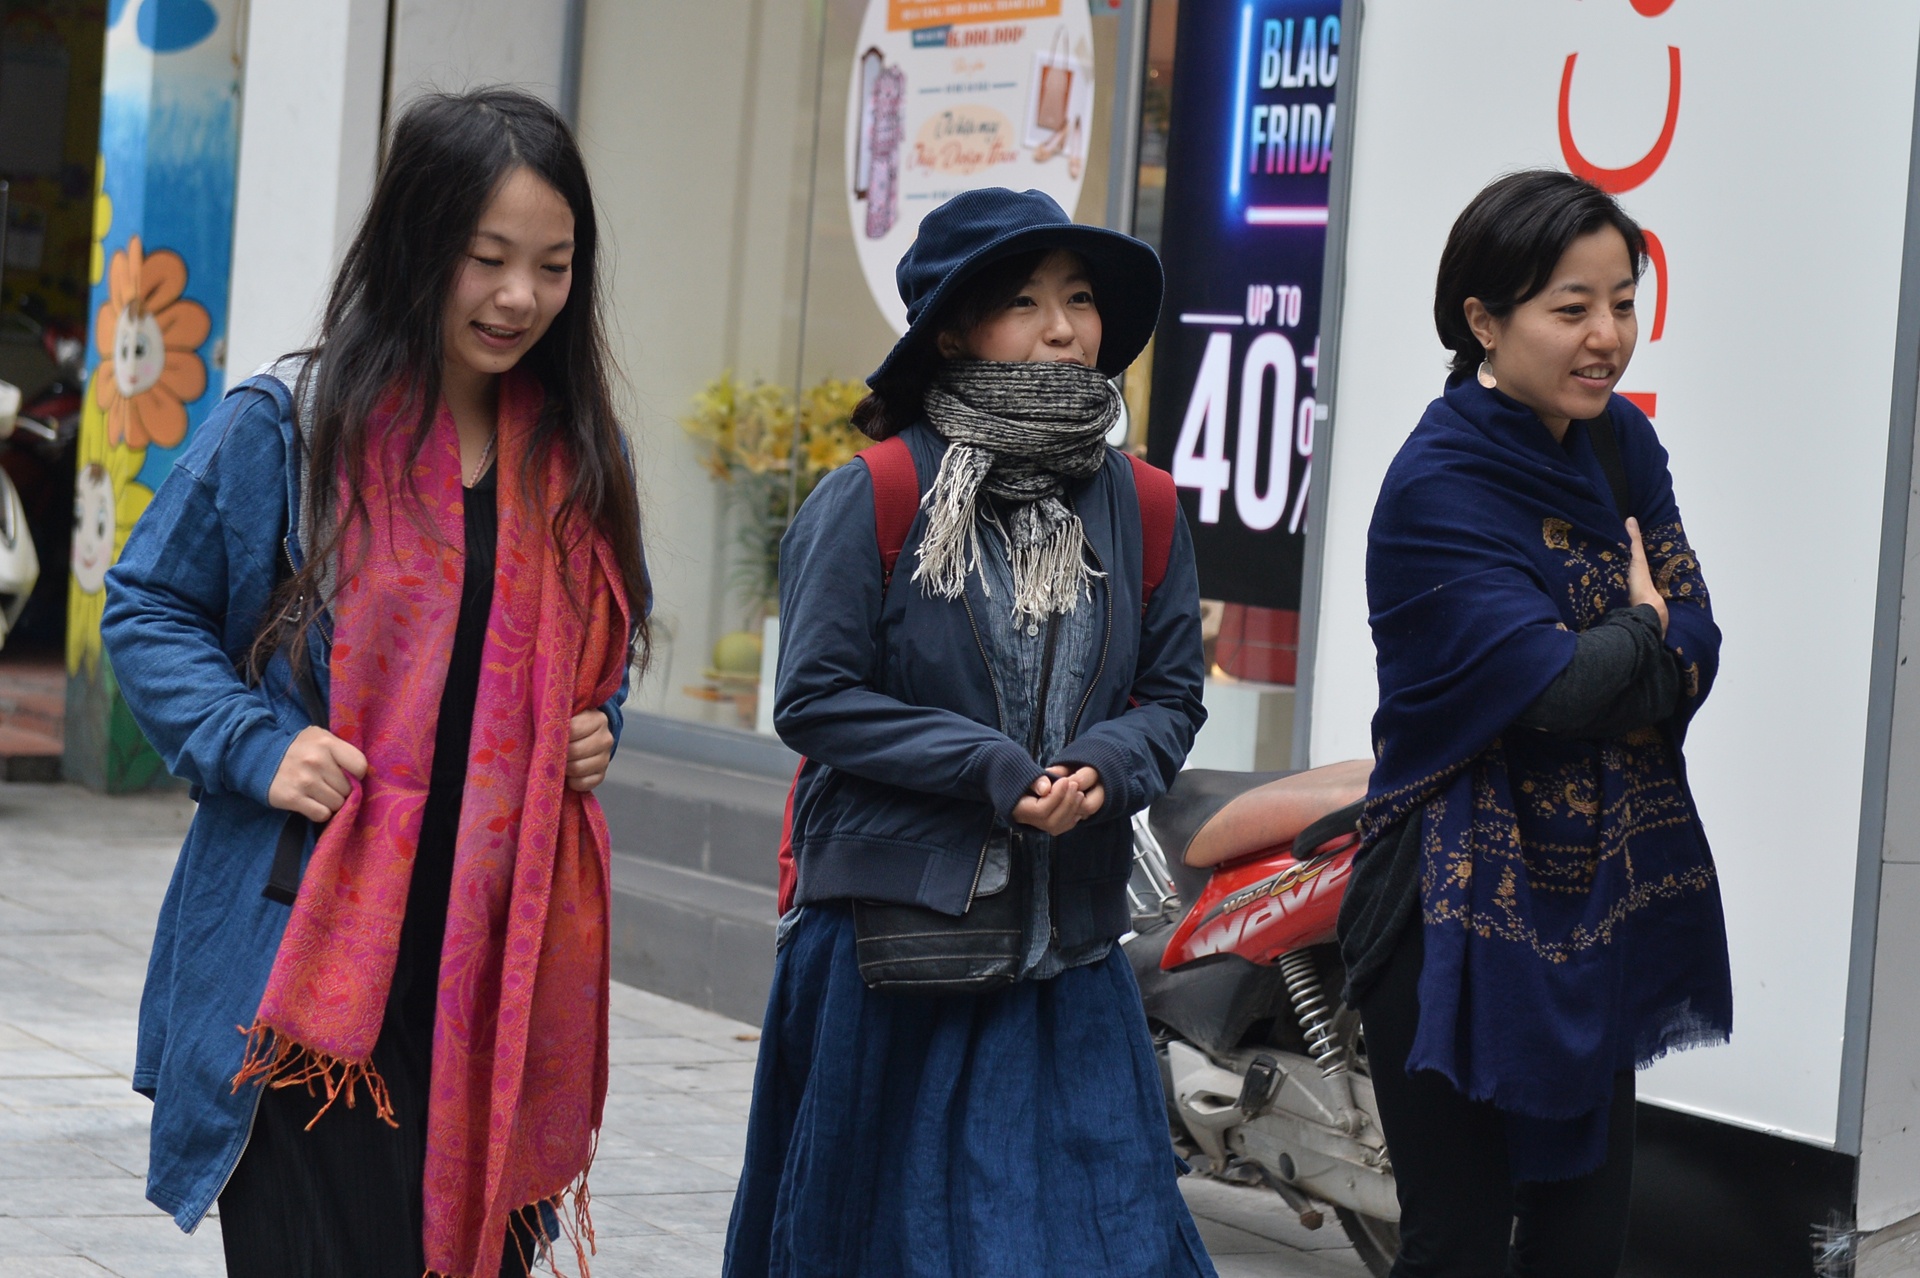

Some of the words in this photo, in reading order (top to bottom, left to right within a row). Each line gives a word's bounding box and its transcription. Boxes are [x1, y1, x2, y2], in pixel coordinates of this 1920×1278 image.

[1259, 15, 1341, 89] BLAC
[1246, 284, 1274, 326] UP
[1277, 285, 1302, 327] TO
